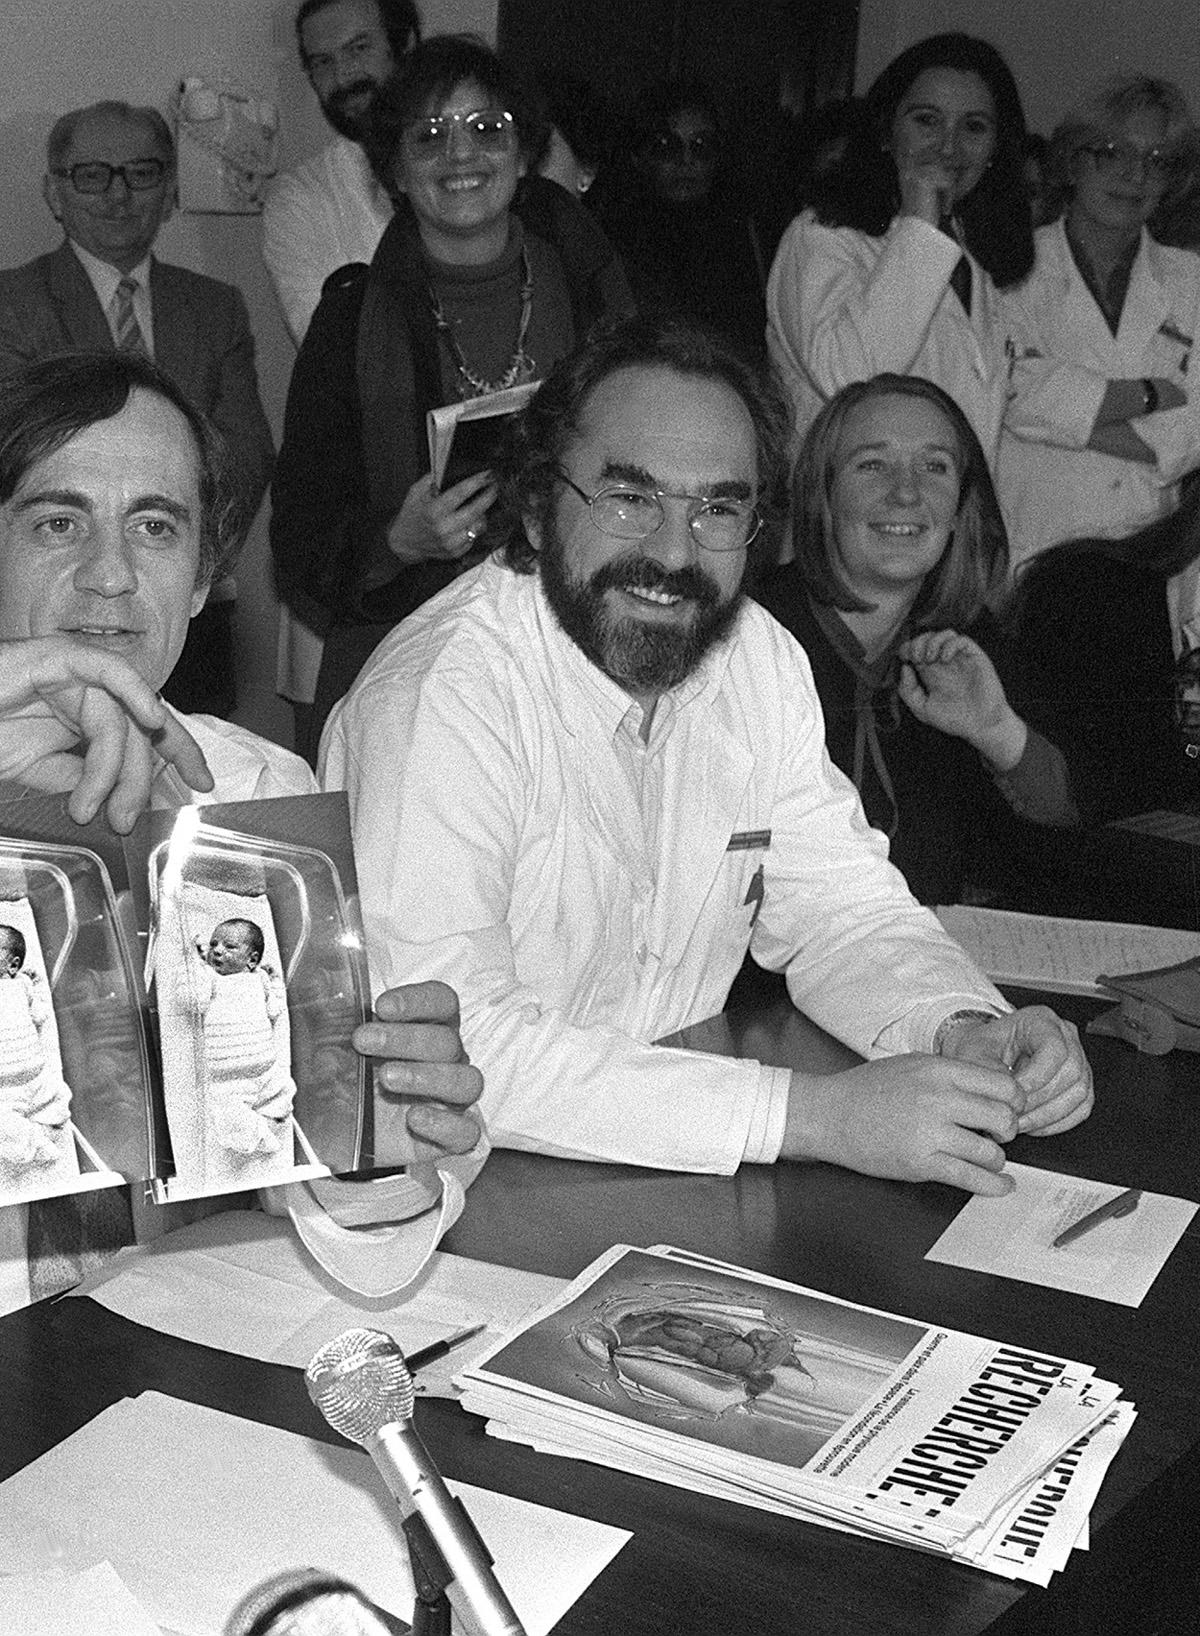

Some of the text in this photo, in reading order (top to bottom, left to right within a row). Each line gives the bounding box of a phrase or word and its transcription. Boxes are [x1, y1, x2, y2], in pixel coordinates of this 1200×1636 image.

[926, 1333, 948, 1351] Guerre
[1056, 1376, 1078, 1389] LA
[906, 1388, 920, 1397] La
[1078, 1395, 1101, 1408] LA
[878, 1347, 1067, 1507] RECHERCHE
